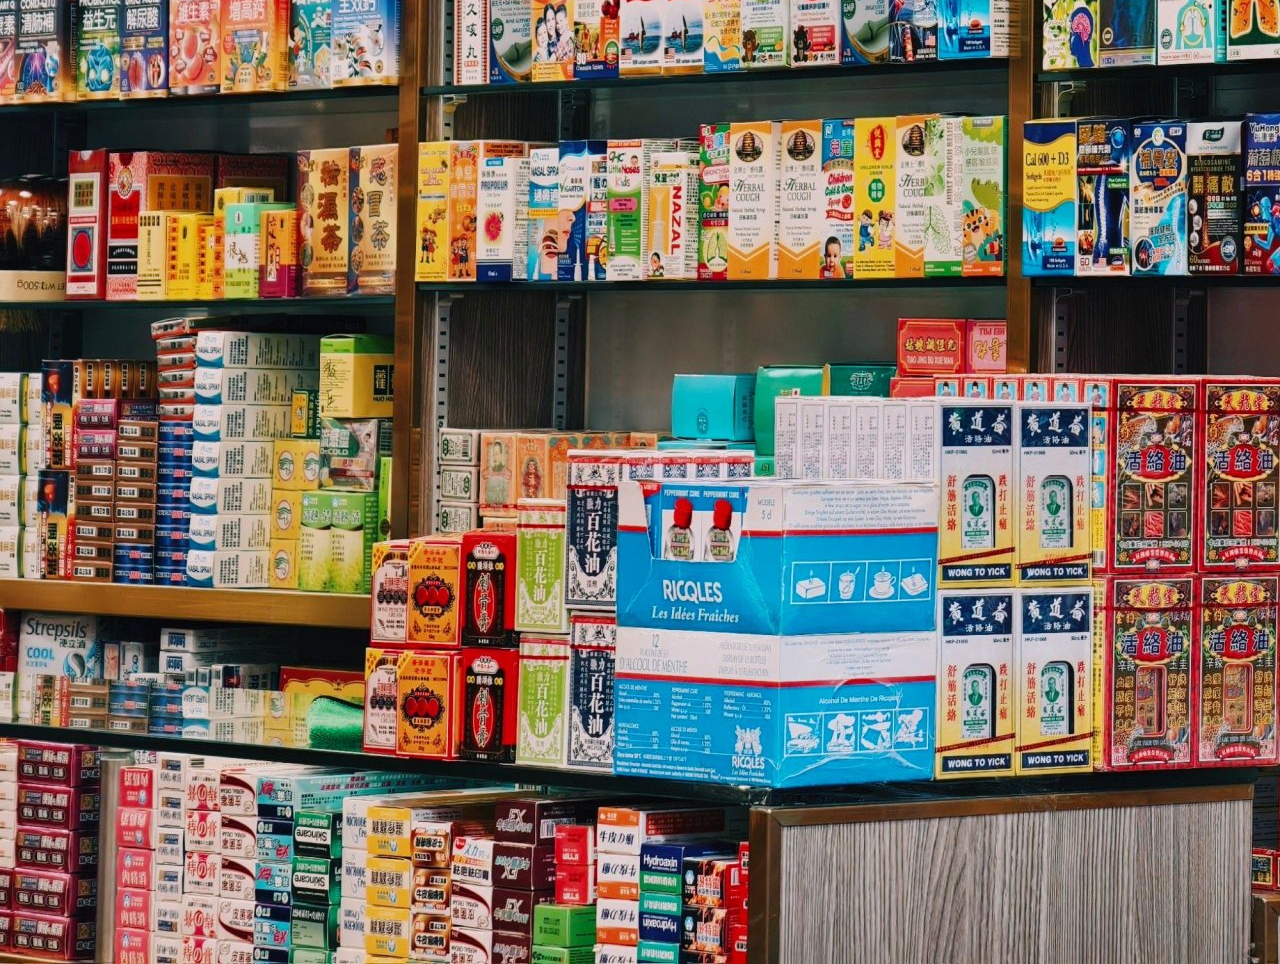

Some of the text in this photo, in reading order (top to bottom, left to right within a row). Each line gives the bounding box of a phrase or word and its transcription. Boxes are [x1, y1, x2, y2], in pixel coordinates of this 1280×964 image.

[1025, 151, 1070, 166] Cal 600 D3
[732, 177, 765, 192] HERBAL
[783, 177, 817, 191] HERBAL
[735, 191, 760, 202] COUGH
[787, 190, 812, 201] COUGH
[671, 186, 682, 255] NAZAL
[664, 489, 700, 498] PEPPERMINT CURE
[703, 490, 740, 499] PEPPERMINT CURE
[584, 512, 601, 573] 百花油
[532, 554, 547, 602] 百花油
[948, 568, 972, 576] WONG
[988, 567, 1005, 575] YICK
[1026, 568, 1051, 576] WONG
[662, 580, 723, 604] RICQLES
[651, 606, 739, 624] Les Idées Fraîches
[25, 618, 86, 641] Strepsils
[26, 646, 54, 659] COOL
[588, 669, 604, 734] 百花油
[731, 755, 765, 769] RICQLES
[948, 758, 1005, 768] WONG TO YICK
[1028, 754, 1084, 764] WONG TO YICK
[643, 854, 678, 868] Hydroaxin
